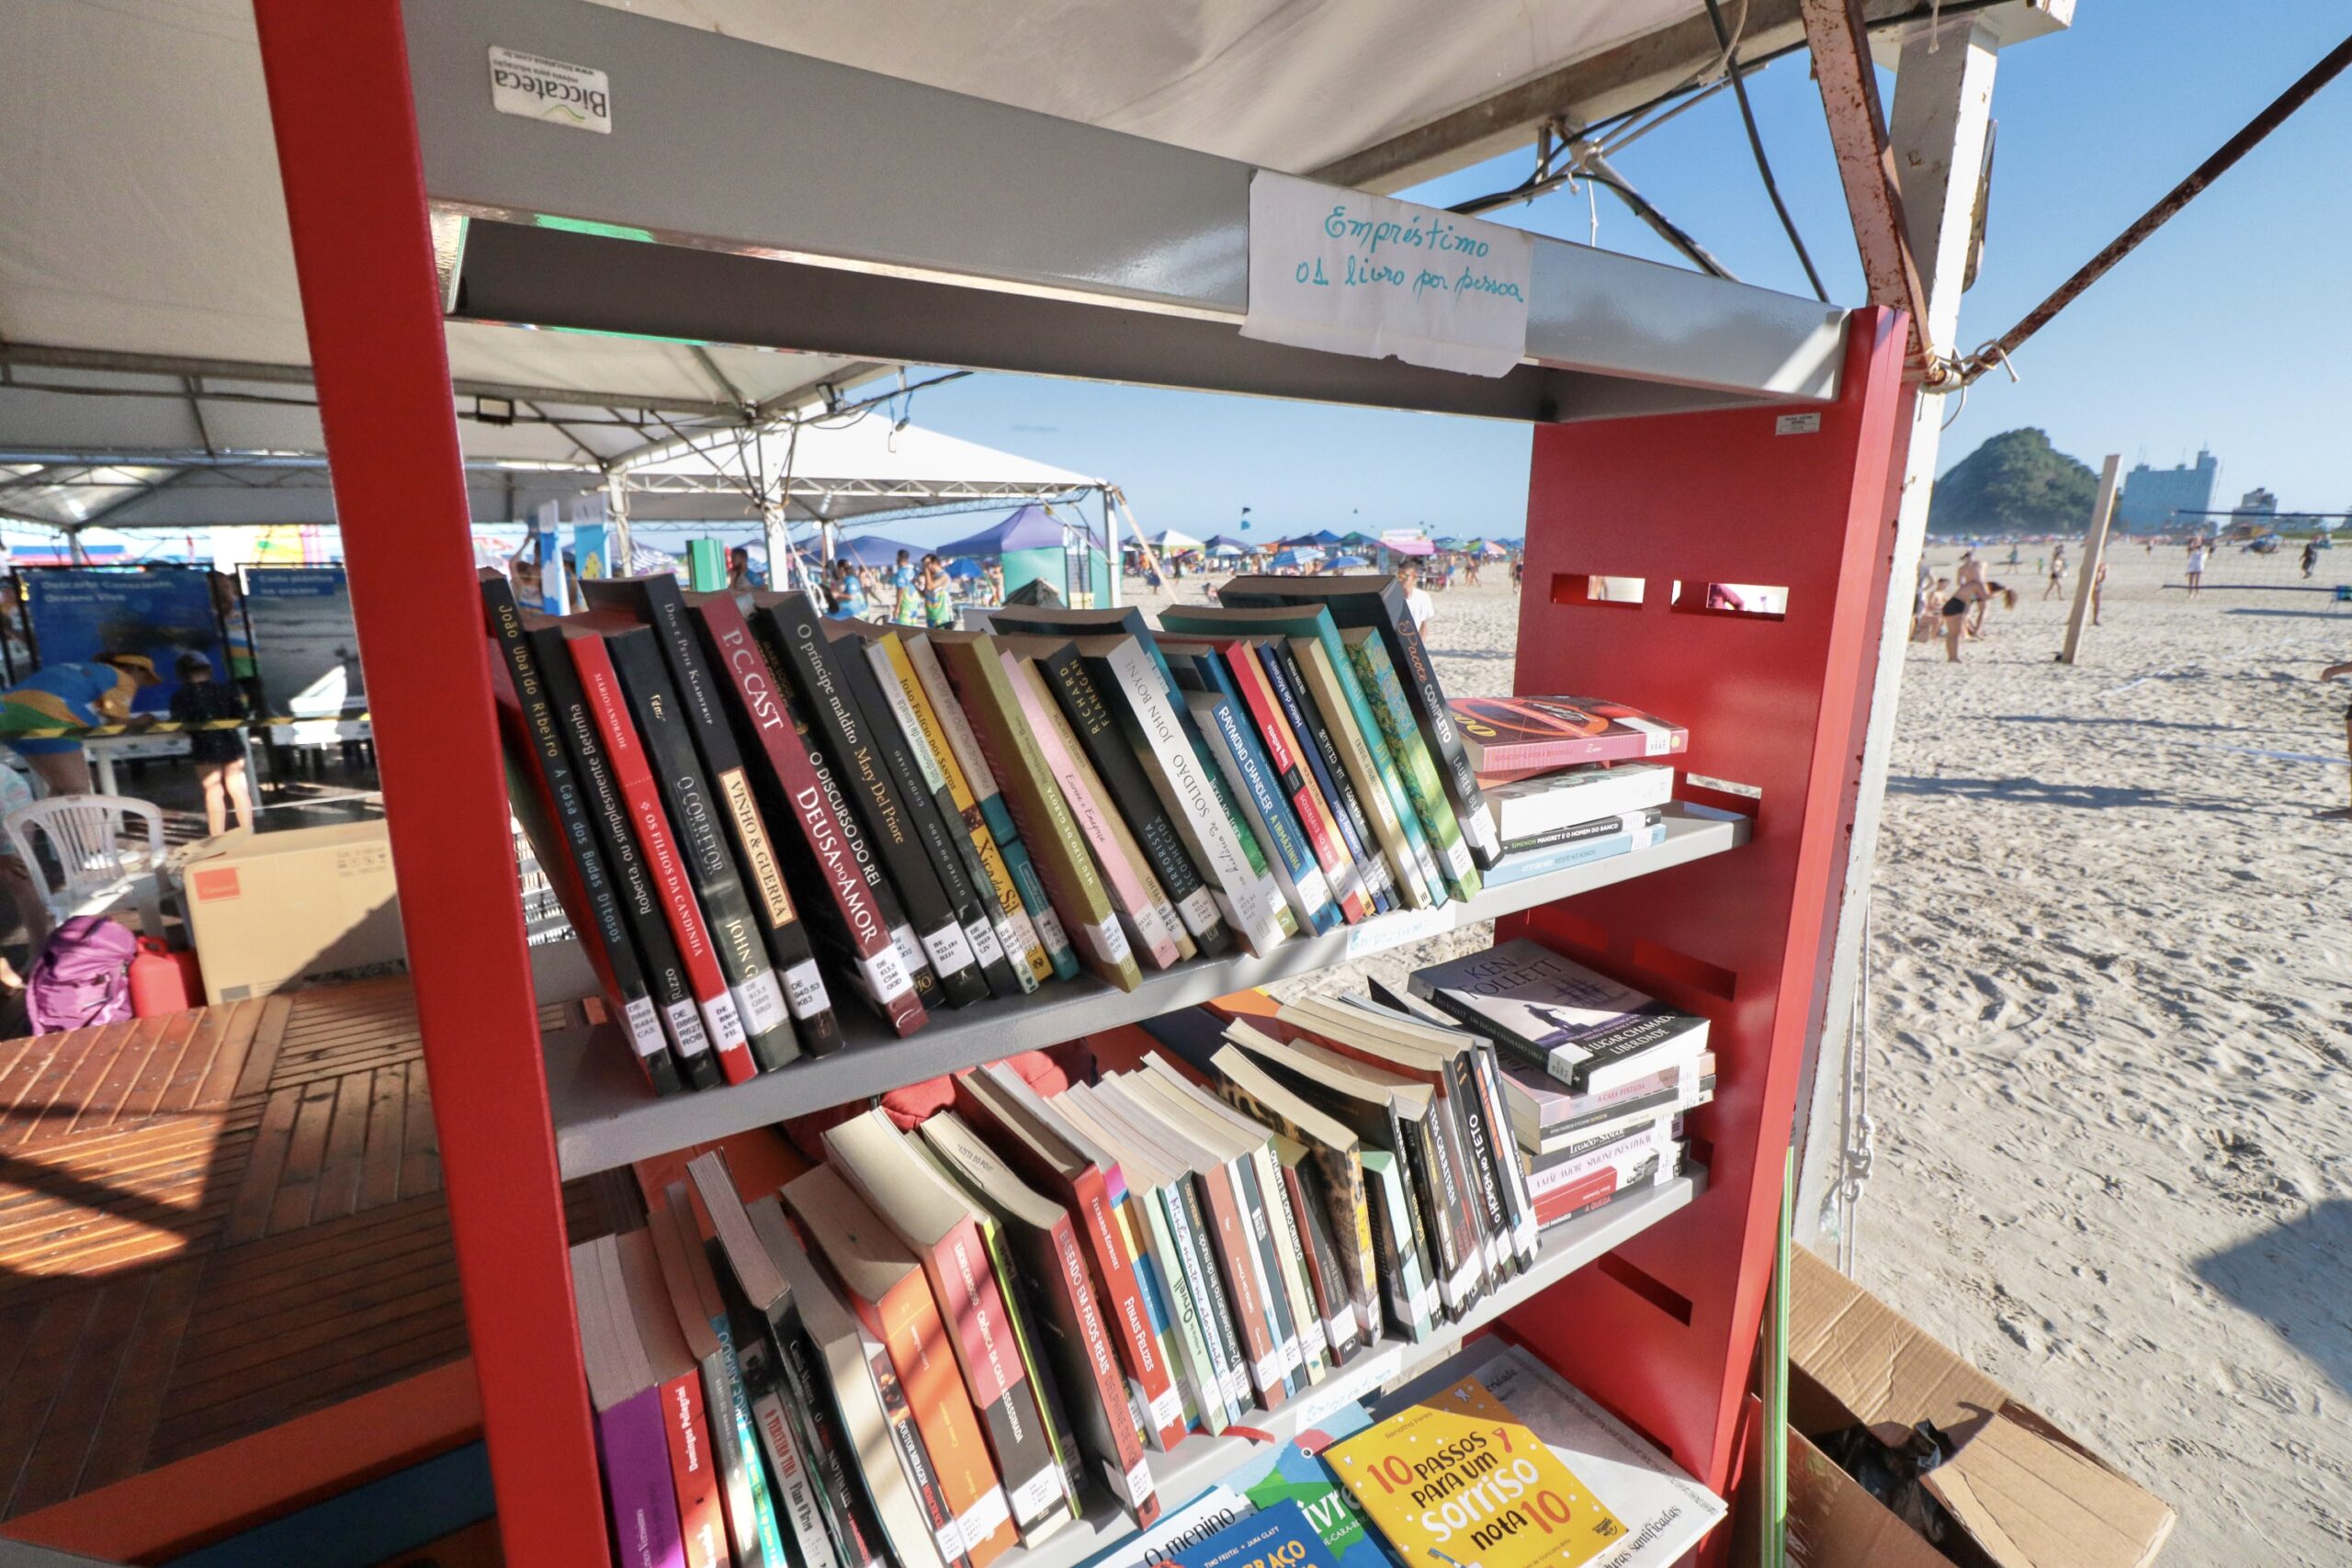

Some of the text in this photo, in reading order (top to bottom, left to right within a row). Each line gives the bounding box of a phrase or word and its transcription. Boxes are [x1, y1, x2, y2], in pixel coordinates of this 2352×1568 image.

[493, 68, 606, 118] Biccateca
[1324, 206, 1489, 257] Empréstimo
[1345, 255, 1406, 286] livro
[1412, 268, 1449, 303] por
[496, 603, 561, 758] João Ubaldo Ribeiro
[687, 669, 716, 726] KLADSTRUP
[740, 670, 784, 735] CAST
[795, 622, 861, 745] O príncipe maldito
[1057, 666, 1101, 734] RICHARD
[1069, 658, 1111, 727] FLANAGAN
[1120, 657, 1154, 705] BOYNE
[1266, 659, 1293, 703] de Moraes
[1395, 617, 1454, 744] Pacote COMPLETO
[1144, 702, 1175, 744] JOHN
[1264, 723, 1291, 767] Tony Bellotto
[1169, 751, 1212, 818] SOLIDÃO
[1216, 705, 1251, 761] RAYMOND
[1240, 758, 1276, 814] CHANDLER
[1451, 755, 1475, 795] LAUREN
[566, 702, 654, 914] Roberta, ou simplesmente Betinha
[808, 750, 881, 886] O DISCURSO DO REI
[850, 747, 908, 845] Mary Del Priore
[907, 778, 925, 807] GUIDO
[1296, 793, 1322, 834] ESPÍRITOS
[554, 767, 624, 943] A Casa dos Budas Ditosos
[674, 773, 726, 877] O CORRETOR
[727, 780, 787, 918] VINHO & GUERRA
[926, 821, 962, 887] LIVRO DO MEDO
[972, 837, 1003, 877] Xica
[1045, 785, 1095, 885] MEU TIPO DE GAROTA
[1152, 814, 1199, 891] ESCONHECIDA
[1268, 814, 1304, 872] A IRMÃZINHA
[1536, 833, 1561, 844] MAIGRET
[1570, 828, 1591, 838] HOMEM
[1599, 822, 1619, 832] BANCO
[643, 813, 704, 958] OS FILHOS DA CANDINHA
[1143, 822, 1187, 895] TERRORISTA
[724, 918, 755, 964] JOHN
[1464, 956, 1517, 981] KEN
[662, 966, 684, 999] Rizzo
[1457, 958, 1563, 1000] FOLLETT
[1591, 1030, 1629, 1052] LUGAR
[1608, 1027, 1670, 1055] LIBERDADE
[1596, 1081, 1646, 1102] A CASA PINTADA
[1425, 1103, 1442, 1136] TESS
[1434, 1135, 1458, 1206] GERRITSEN
[1465, 1113, 1488, 1159] TETO
[1478, 1156, 1489, 1171] NO
[1090, 1197, 1110, 1235] FERNANDO
[1268, 1148, 1304, 1260] O OUTRO OLHO DE LAMPIÃO
[1480, 1172, 1499, 1214] HOMEM
[1492, 1213, 1502, 1224] O
[1583, 1195, 1612, 1213] A QUEDA
[952, 1242, 981, 1306] LÚCIO CARDOSO
[1056, 1229, 1112, 1376] BASEADO EM FATOS REAIS
[1170, 1276, 1196, 1324] Orwell
[1195, 1233, 1231, 1329] aventura no fim do mundo
[1121, 1295, 1159, 1371] FINAIS FELIZES
[1182, 1246, 1224, 1368] mente me atormenta
[717, 1330, 741, 1385] AMADO
[974, 1309, 1026, 1444] CRÔNICA DA CASA ASSASSINADA
[673, 1384, 701, 1472] Domingos Pellegrini
[1102, 1375, 1133, 1444] DELPHINE DE
[762, 1408, 808, 1506] O TERCEIRO TIRA Flann
[896, 1419, 931, 1486] DOUTOR MIRAGEM
[1367, 1431, 1488, 1495] 10 PASSOS
[1165, 1507, 1236, 1556] menino
[1420, 1458, 1539, 1543] sorriso
[1521, 1490, 1572, 1535] 10
[1632, 1505, 1682, 1553] santificadas
